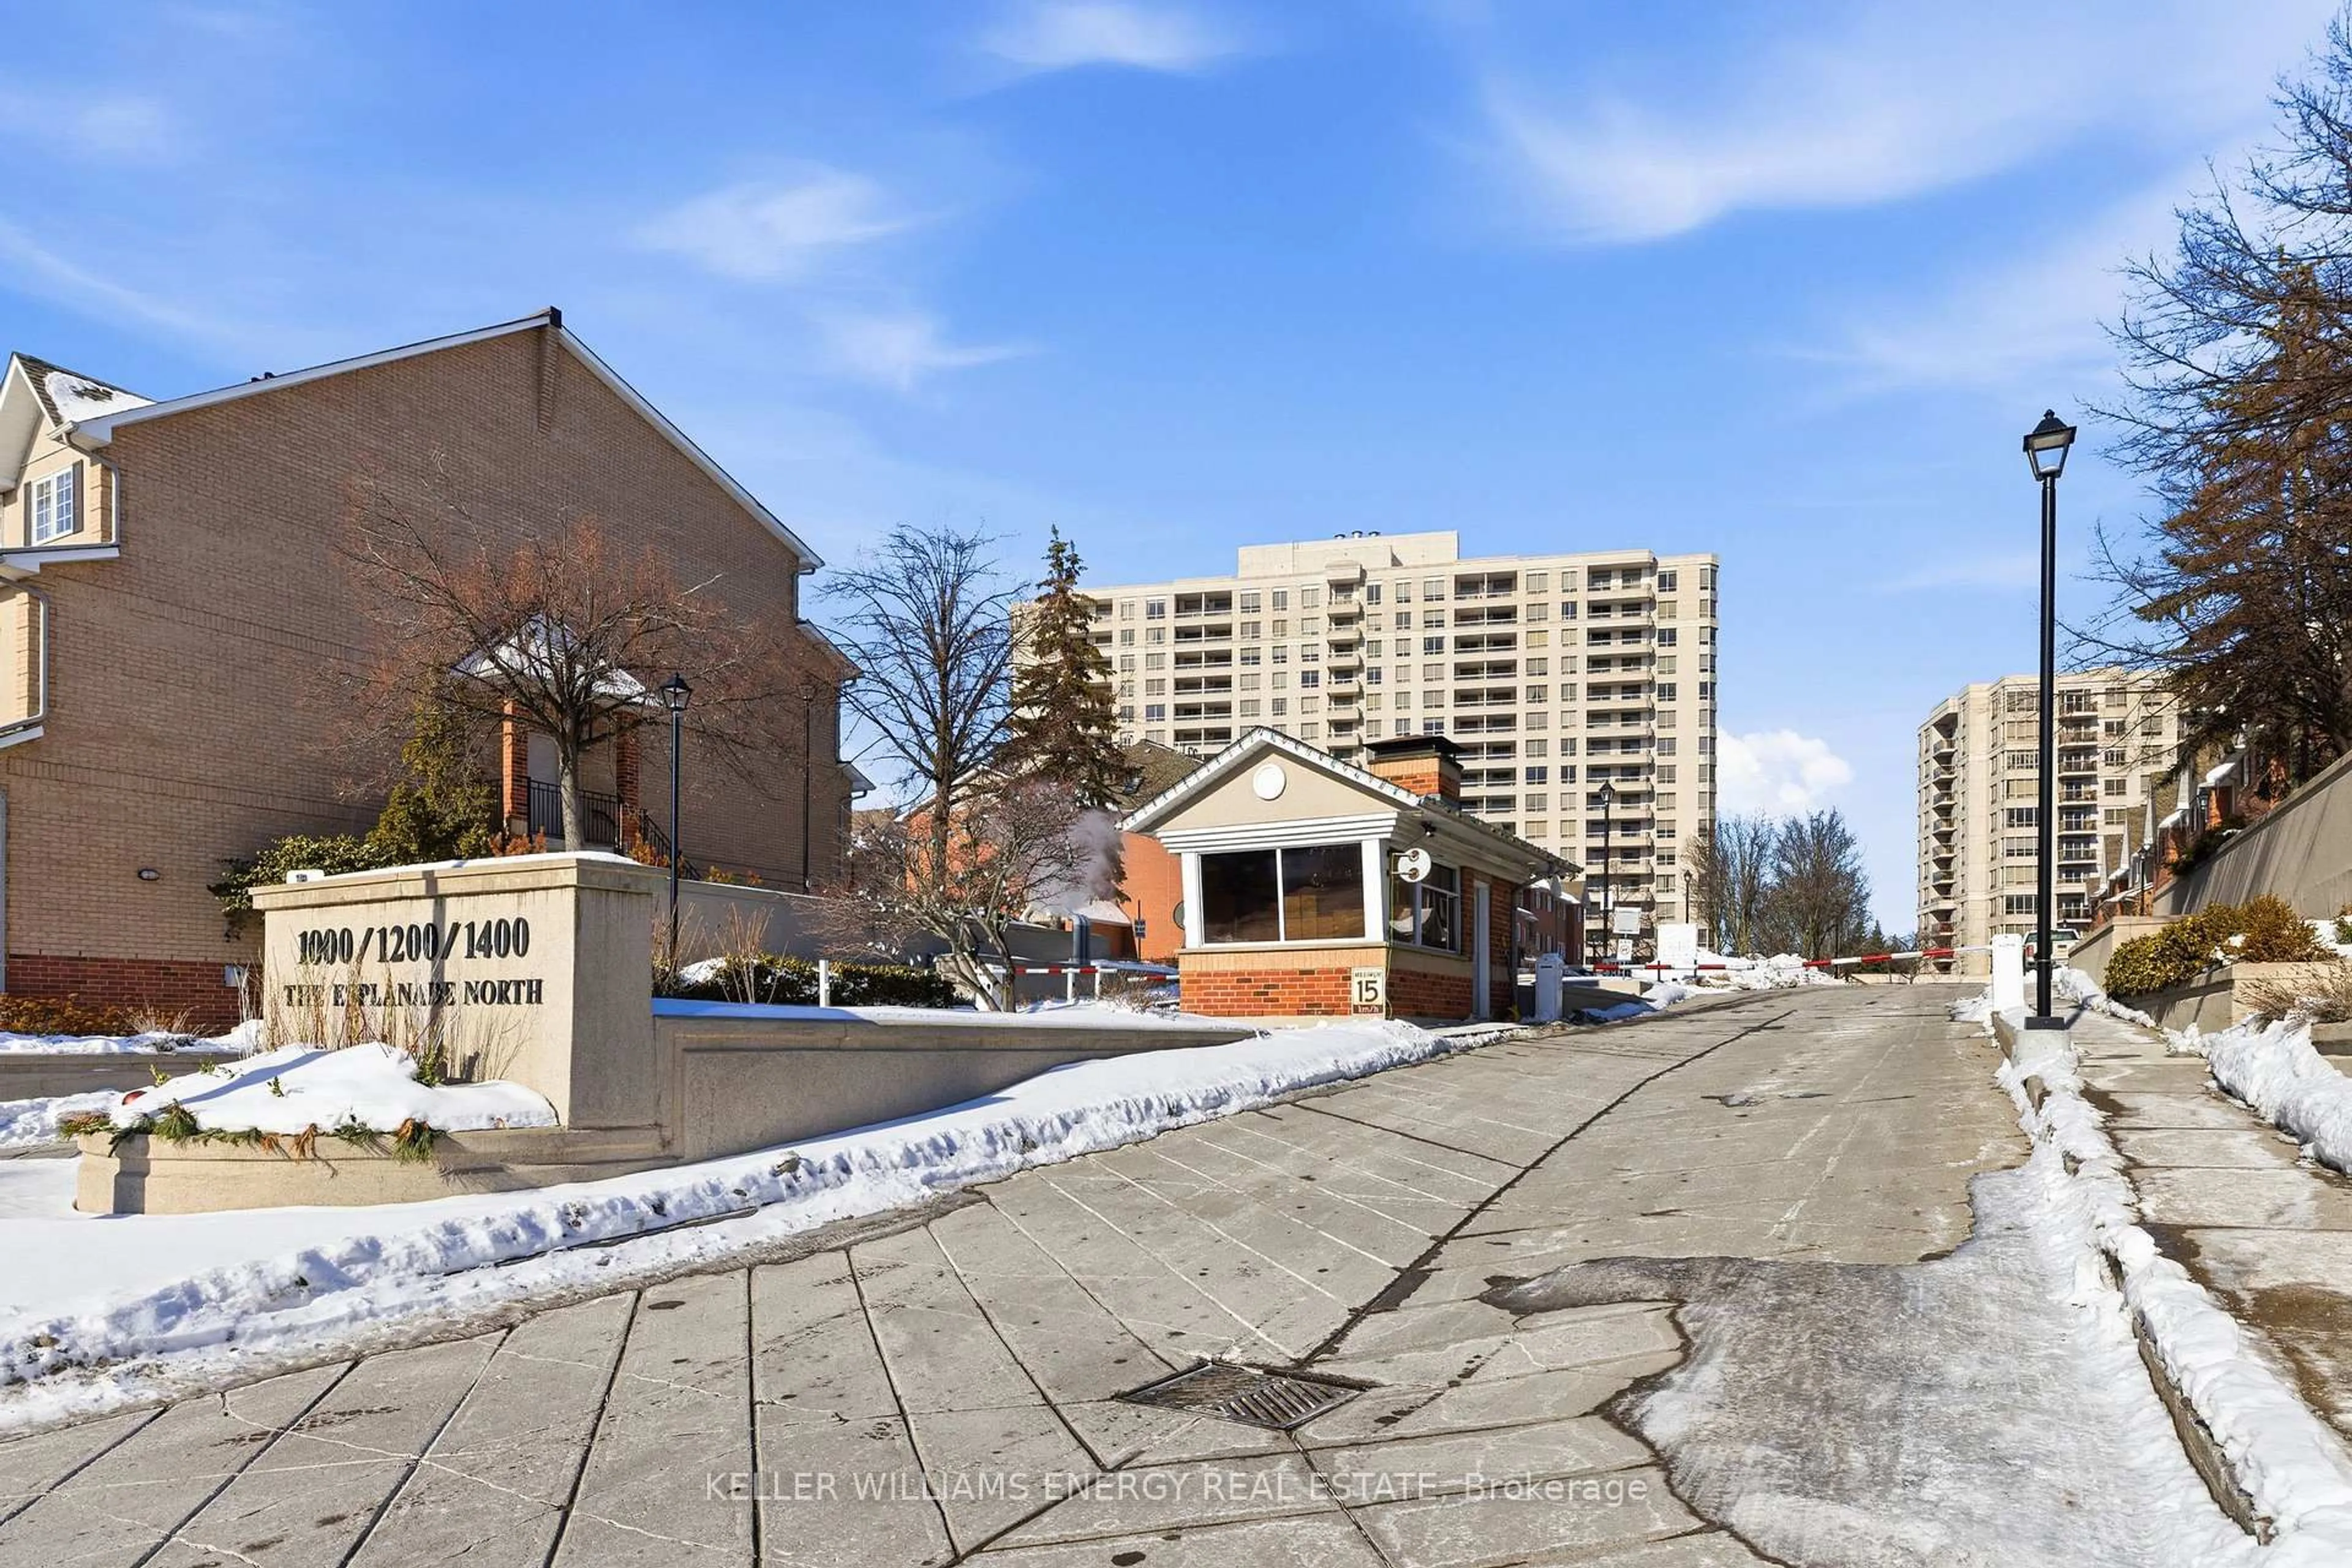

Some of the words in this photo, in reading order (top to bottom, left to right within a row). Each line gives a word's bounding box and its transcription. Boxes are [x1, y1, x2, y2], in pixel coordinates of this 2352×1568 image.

[333, 981, 456, 1006] EPLANADE
[464, 979, 543, 1005] NORTH
[1357, 980, 1378, 1002] 15
